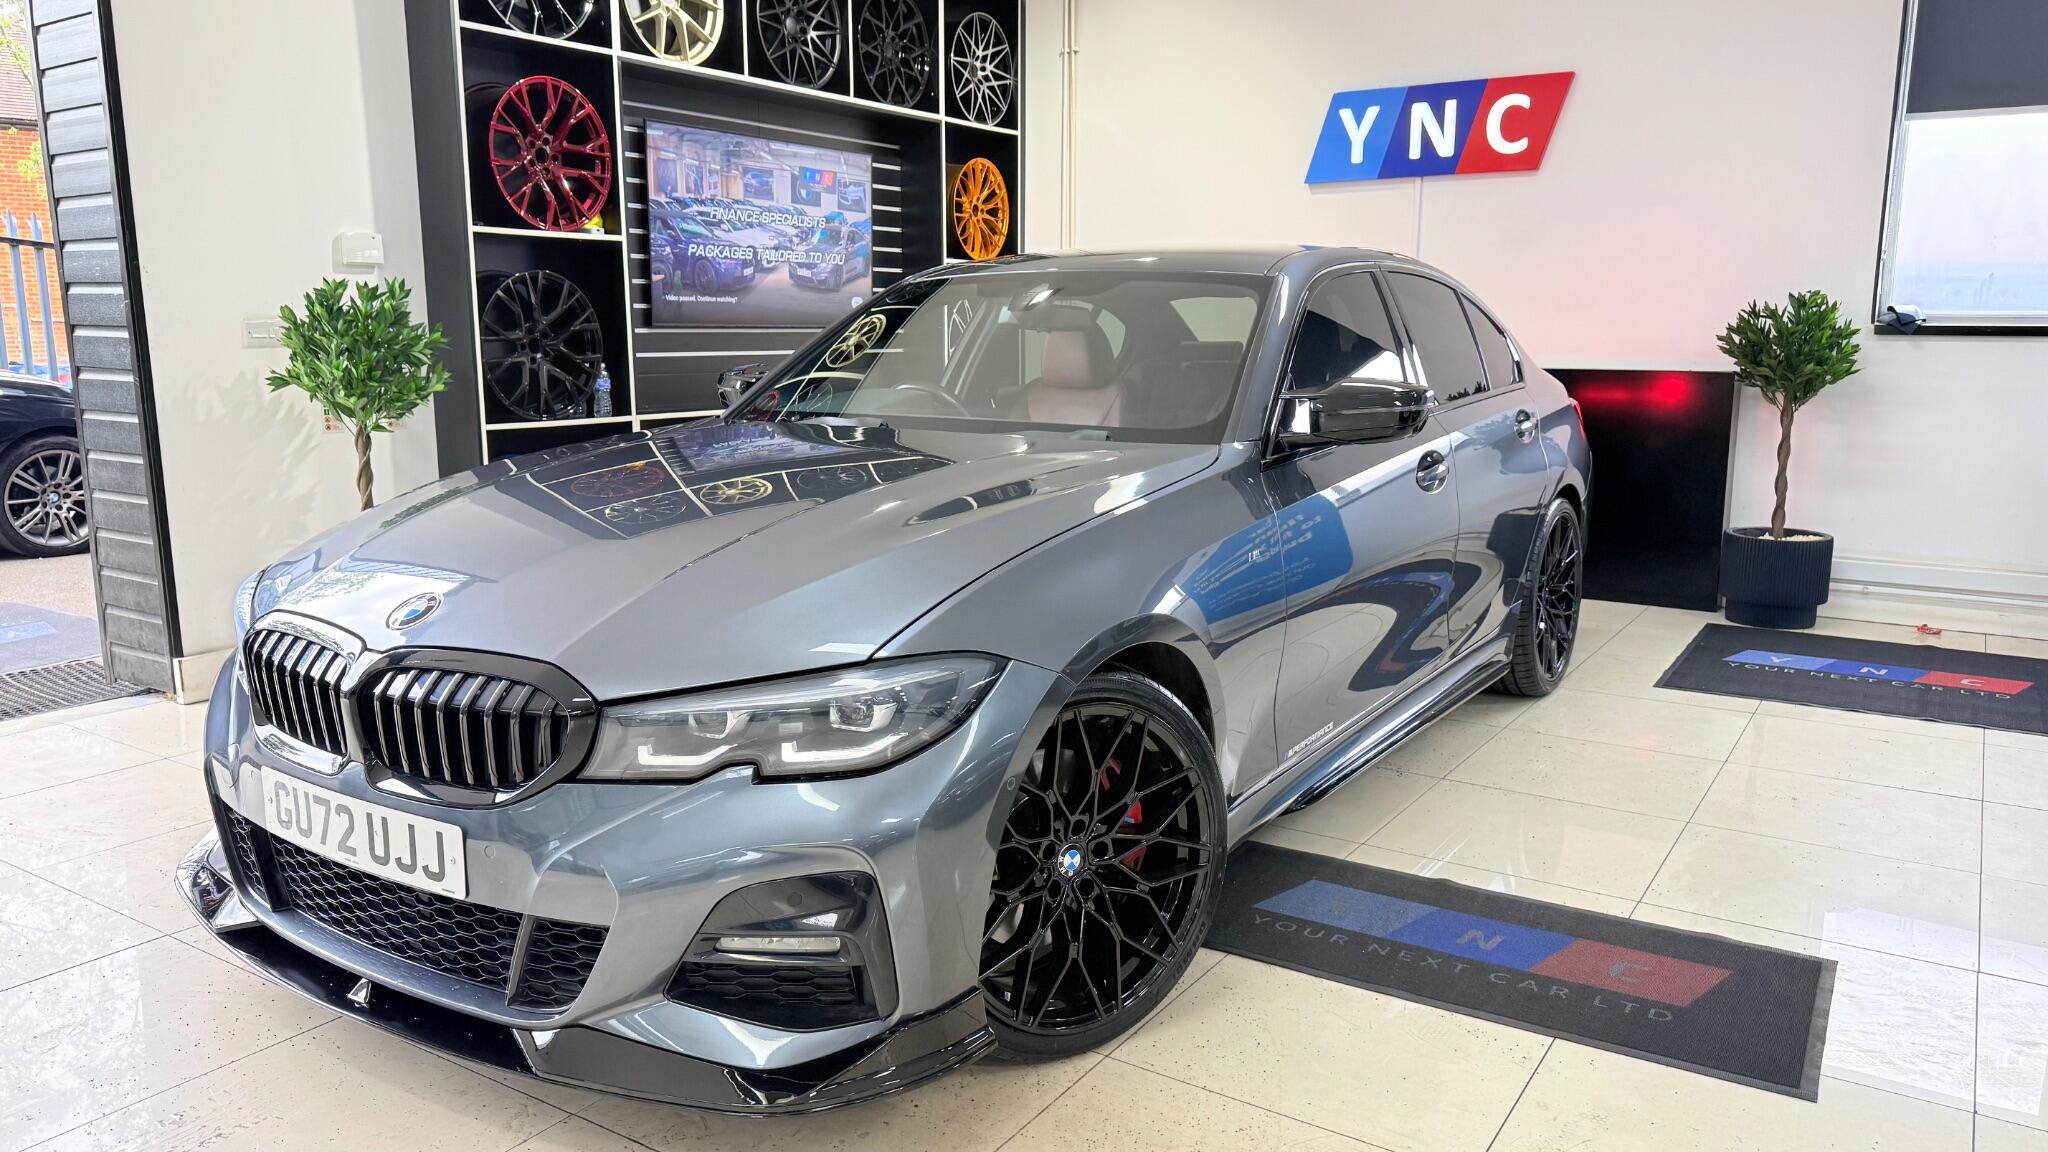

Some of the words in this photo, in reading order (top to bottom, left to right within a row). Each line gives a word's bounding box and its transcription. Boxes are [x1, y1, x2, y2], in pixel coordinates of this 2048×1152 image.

[1338, 93, 1531, 164] YNC
[710, 207, 759, 223] FINANCE
[761, 211, 826, 228] SPECIALISTS
[688, 244, 753, 260] PACKAGES
[757, 248, 806, 262] TAILORED
[808, 252, 822, 264] TO
[825, 253, 845, 265] YOU
[1729, 662, 1795, 674] YOUR
[1810, 671, 1878, 683] NEXT
[1891, 681, 1943, 691] CAR
[1960, 689, 2010, 699] LTD
[273, 780, 357, 857] GU72
[366, 811, 446, 883] UJJ
[1253, 914, 1350, 946] YOUR
[1367, 943, 1471, 974] NEXT
[1487, 972, 1569, 999] CAR
[1592, 995, 1673, 1021] LTD
